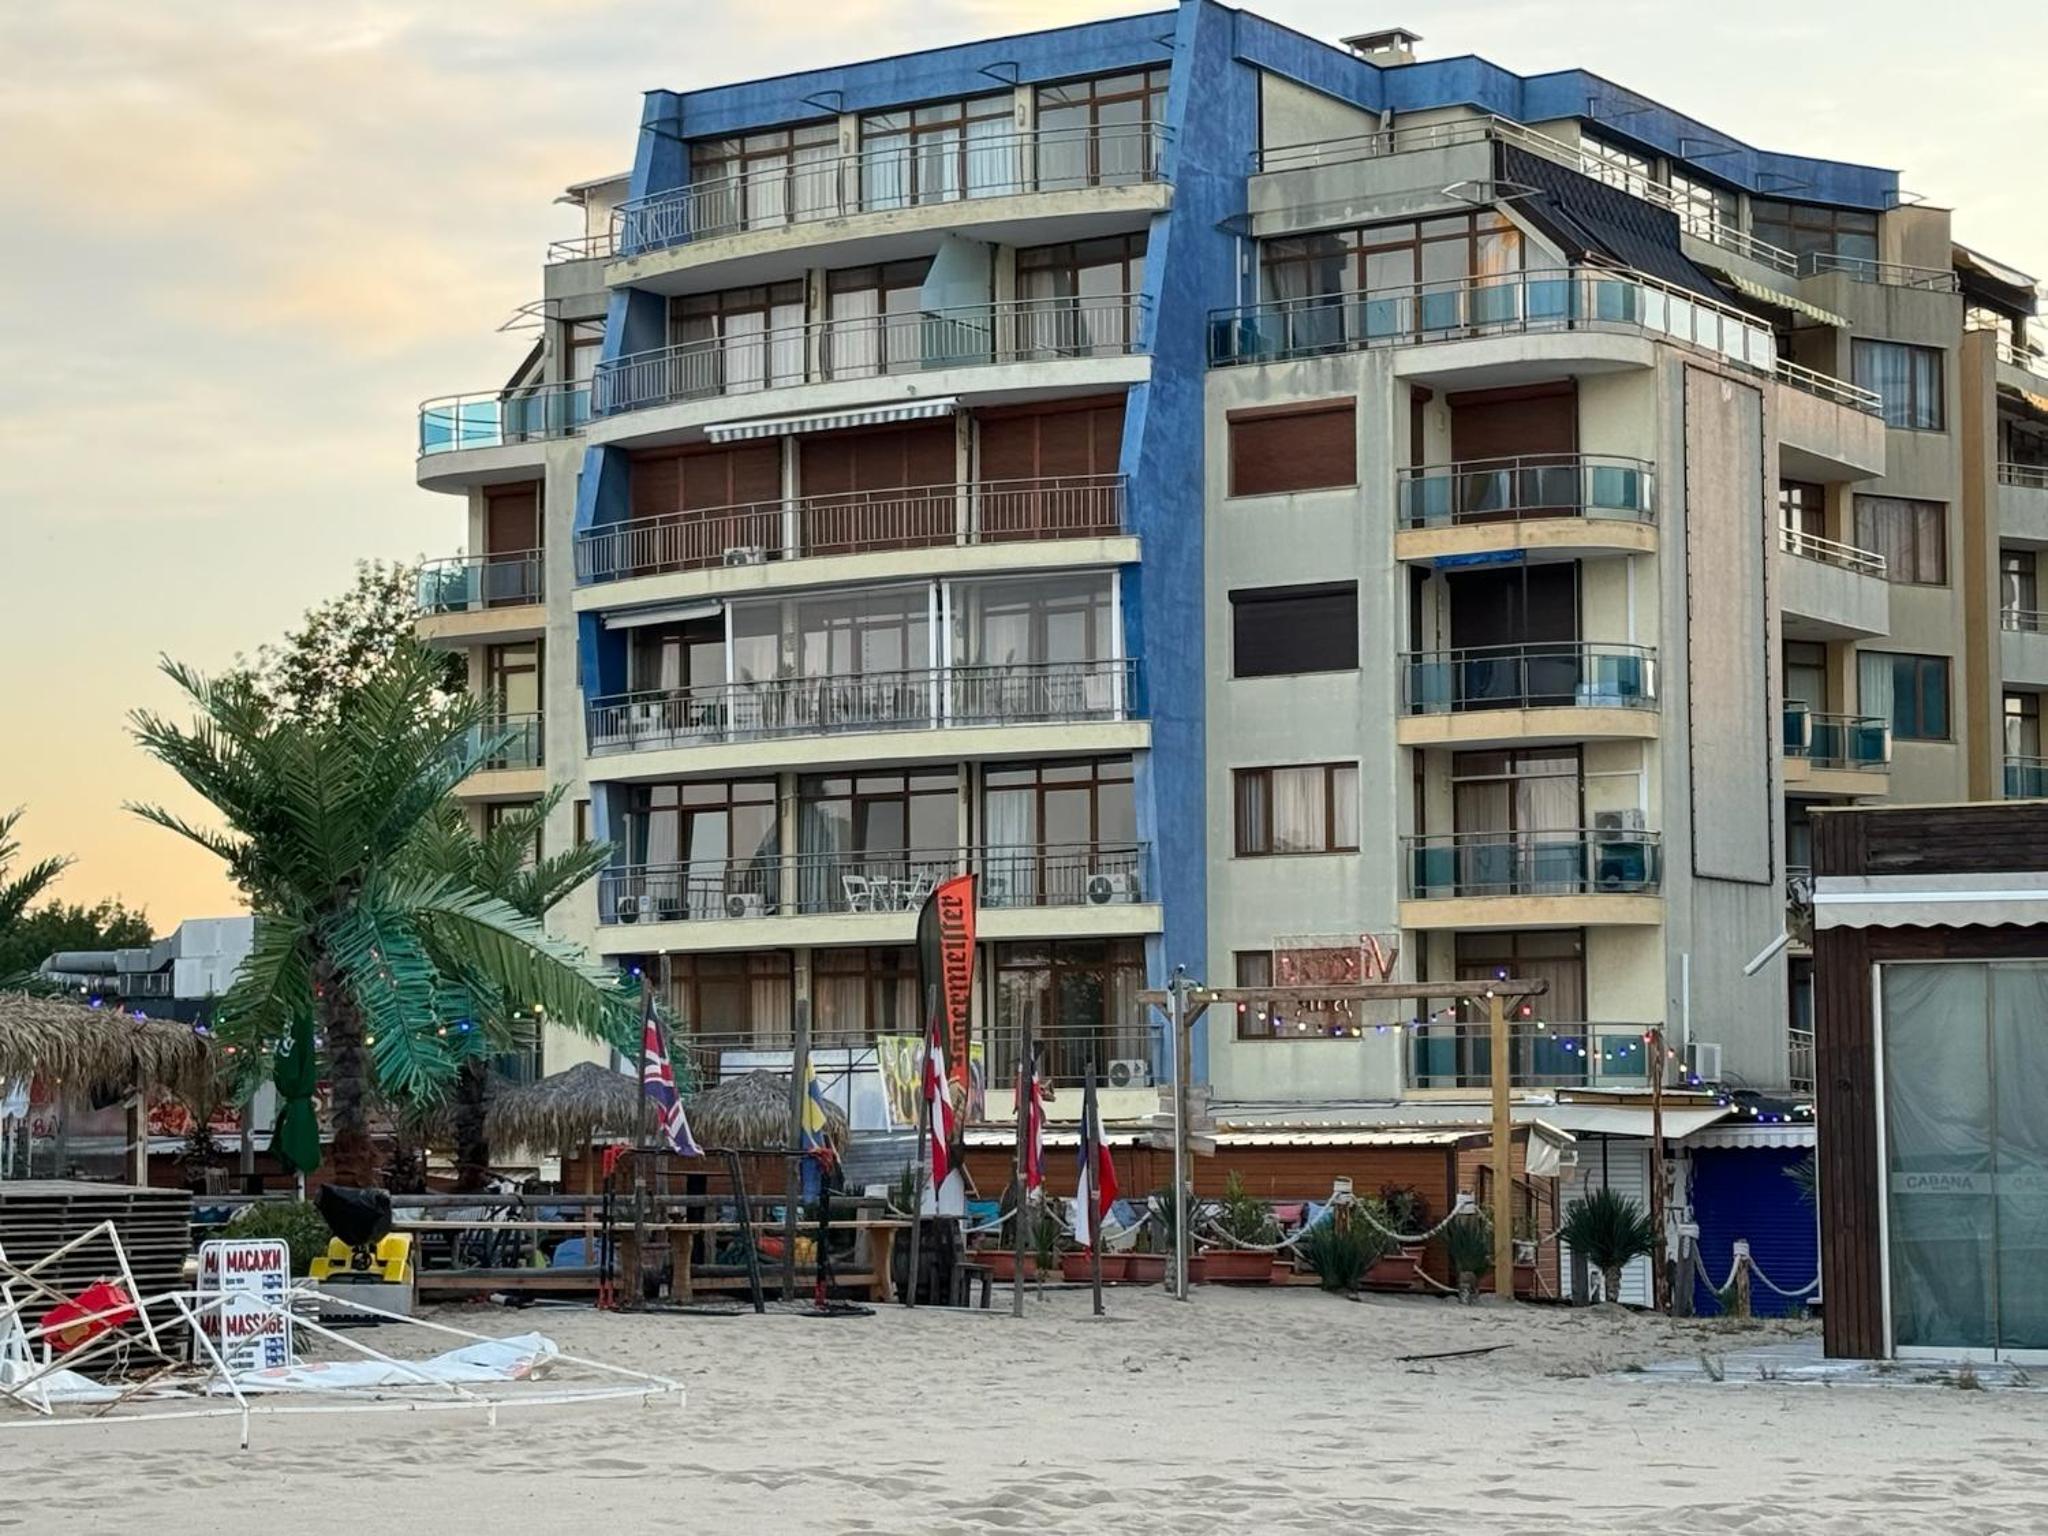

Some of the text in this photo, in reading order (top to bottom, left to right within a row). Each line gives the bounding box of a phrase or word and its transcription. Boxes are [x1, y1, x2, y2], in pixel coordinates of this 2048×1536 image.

[1906, 1175, 1974, 1190] CABANA
[226, 1249, 282, 1272] МАСАЖИ
[226, 1313, 284, 1337] MASSAGE
